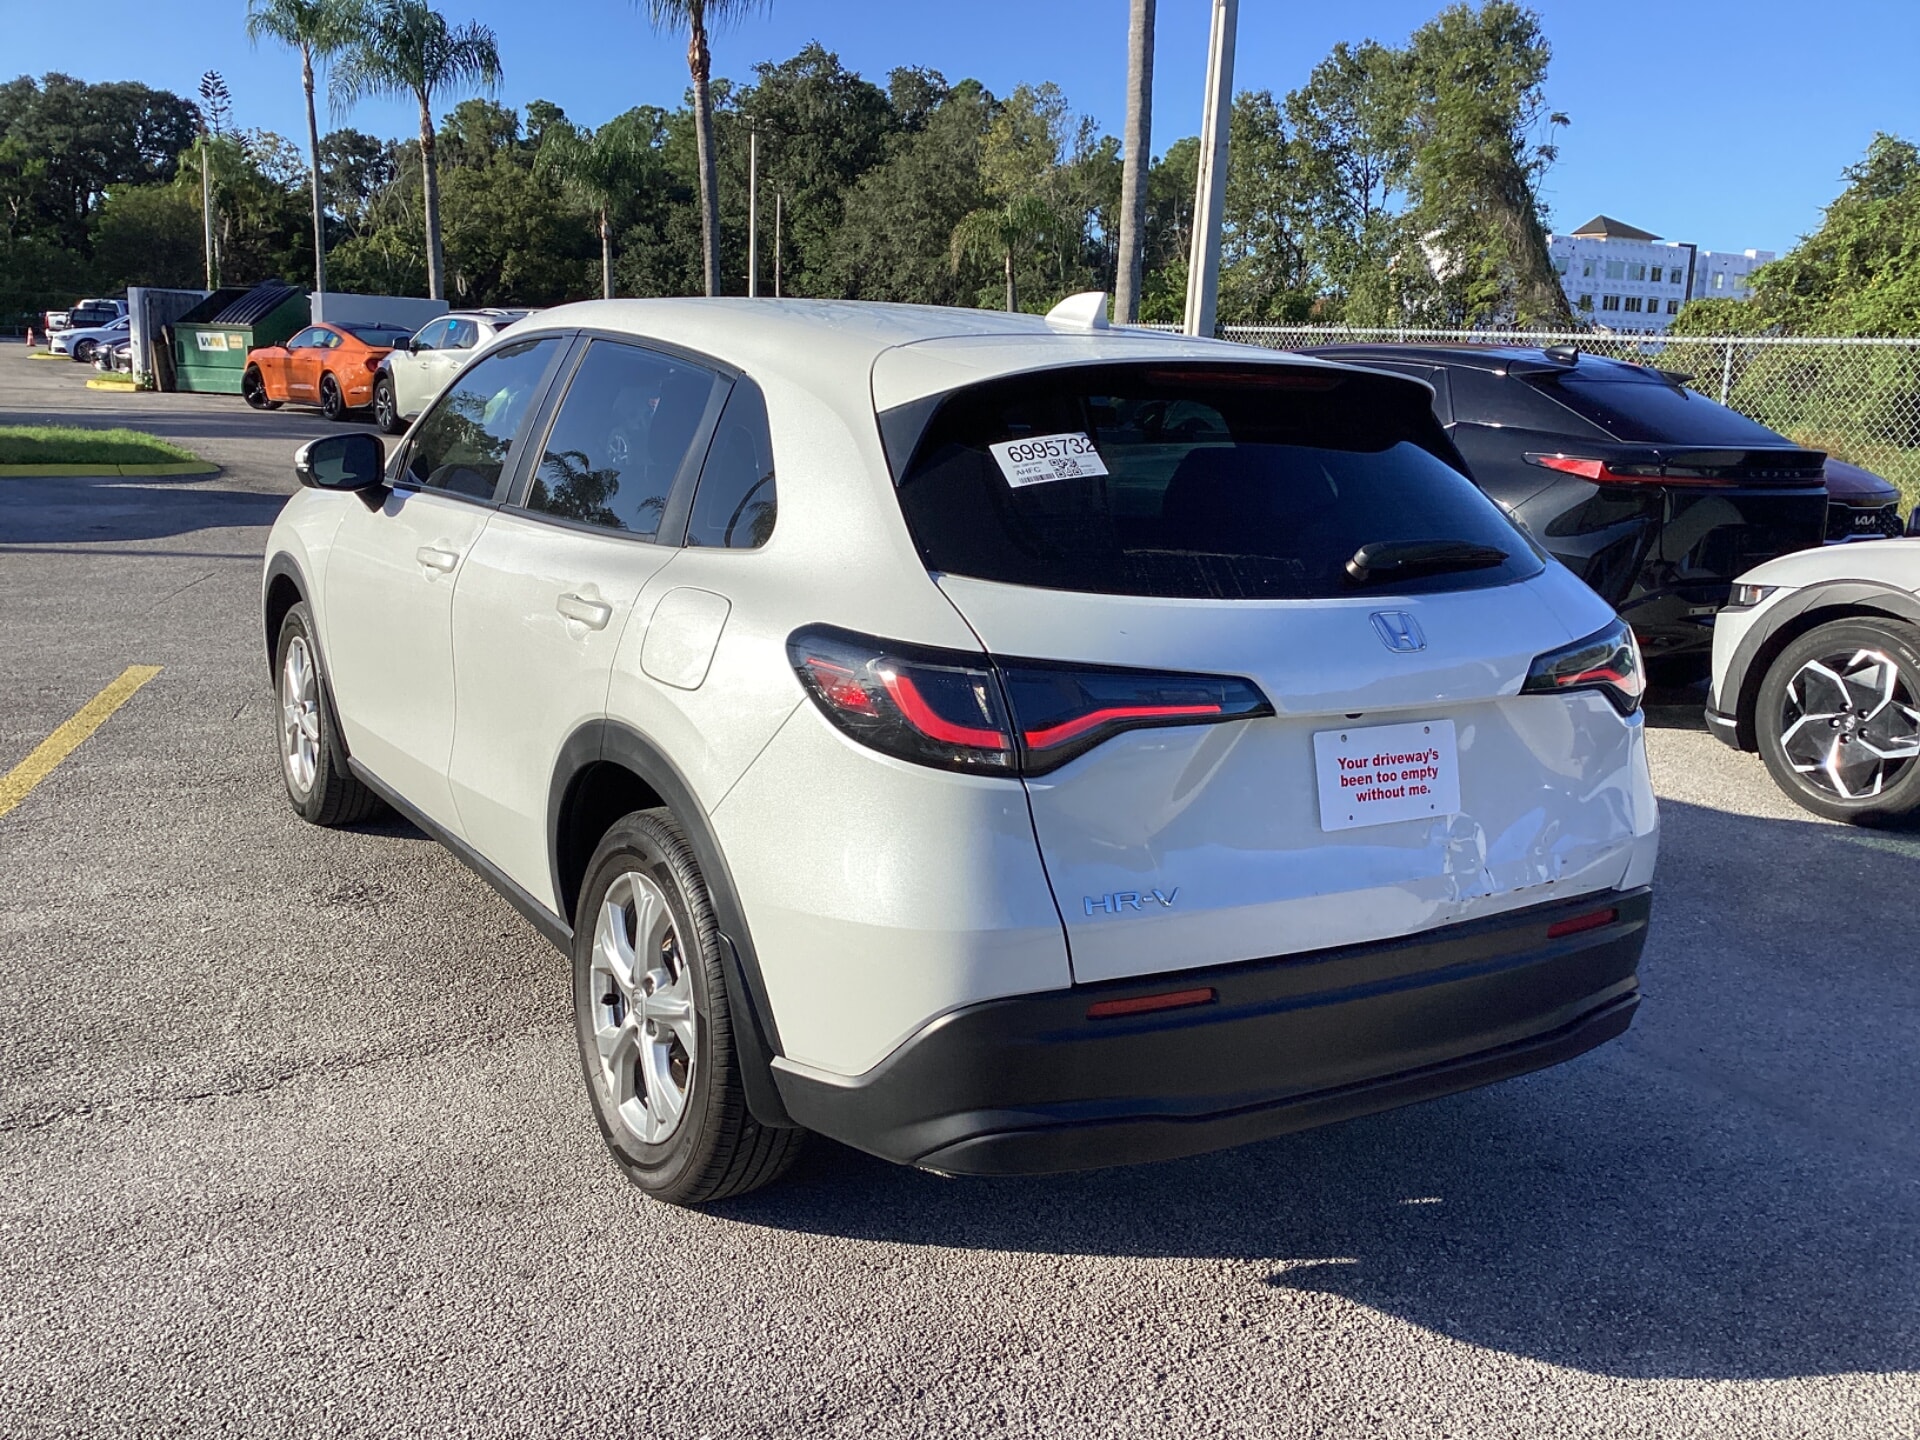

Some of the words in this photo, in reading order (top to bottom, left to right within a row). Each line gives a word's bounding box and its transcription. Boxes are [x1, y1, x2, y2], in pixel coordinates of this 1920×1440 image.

[1007, 436, 1097, 463] 6995732
[1855, 515, 1876, 526] KIA
[1337, 757, 1369, 770] Your
[1372, 748, 1439, 767] driveway's
[1340, 774, 1373, 788] been
[1376, 771, 1397, 783] too
[1401, 765, 1439, 781] empty
[1356, 785, 1405, 802] without
[1409, 785, 1431, 797] me.
[1083, 886, 1180, 916] HR-V
